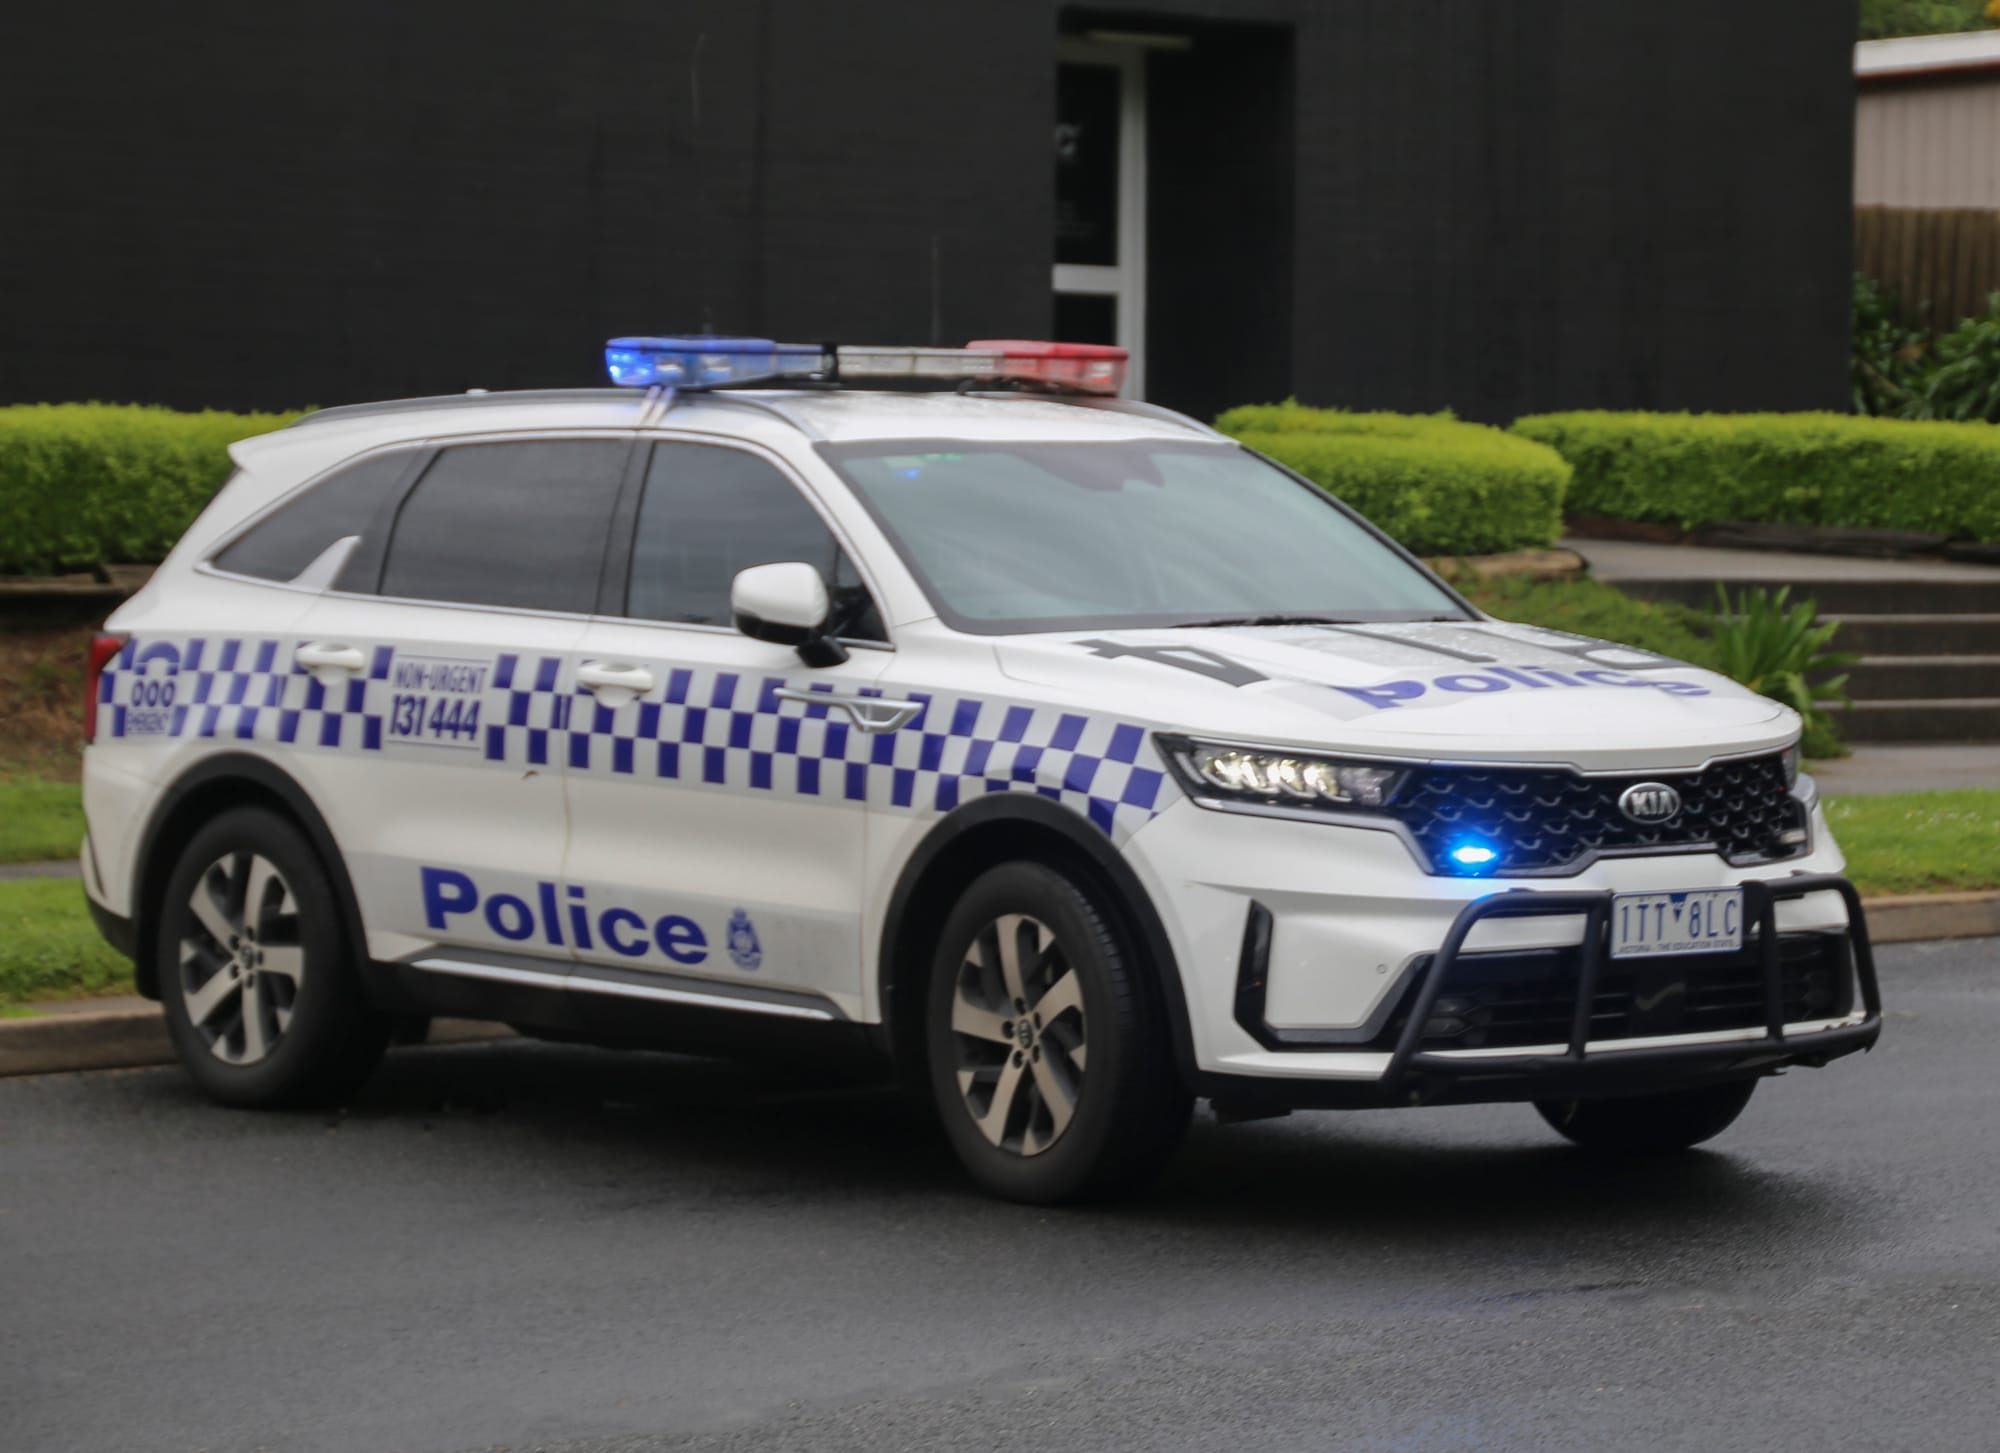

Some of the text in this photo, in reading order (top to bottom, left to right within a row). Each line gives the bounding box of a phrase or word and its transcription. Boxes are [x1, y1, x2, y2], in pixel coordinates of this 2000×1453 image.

[131, 680, 176, 707] 000
[393, 662, 488, 693] NON-URGENT
[389, 694, 482, 741] 131 444
[1631, 791, 1673, 815] KIA
[420, 866, 708, 965] Police
[1689, 899, 1736, 938] 8LC
